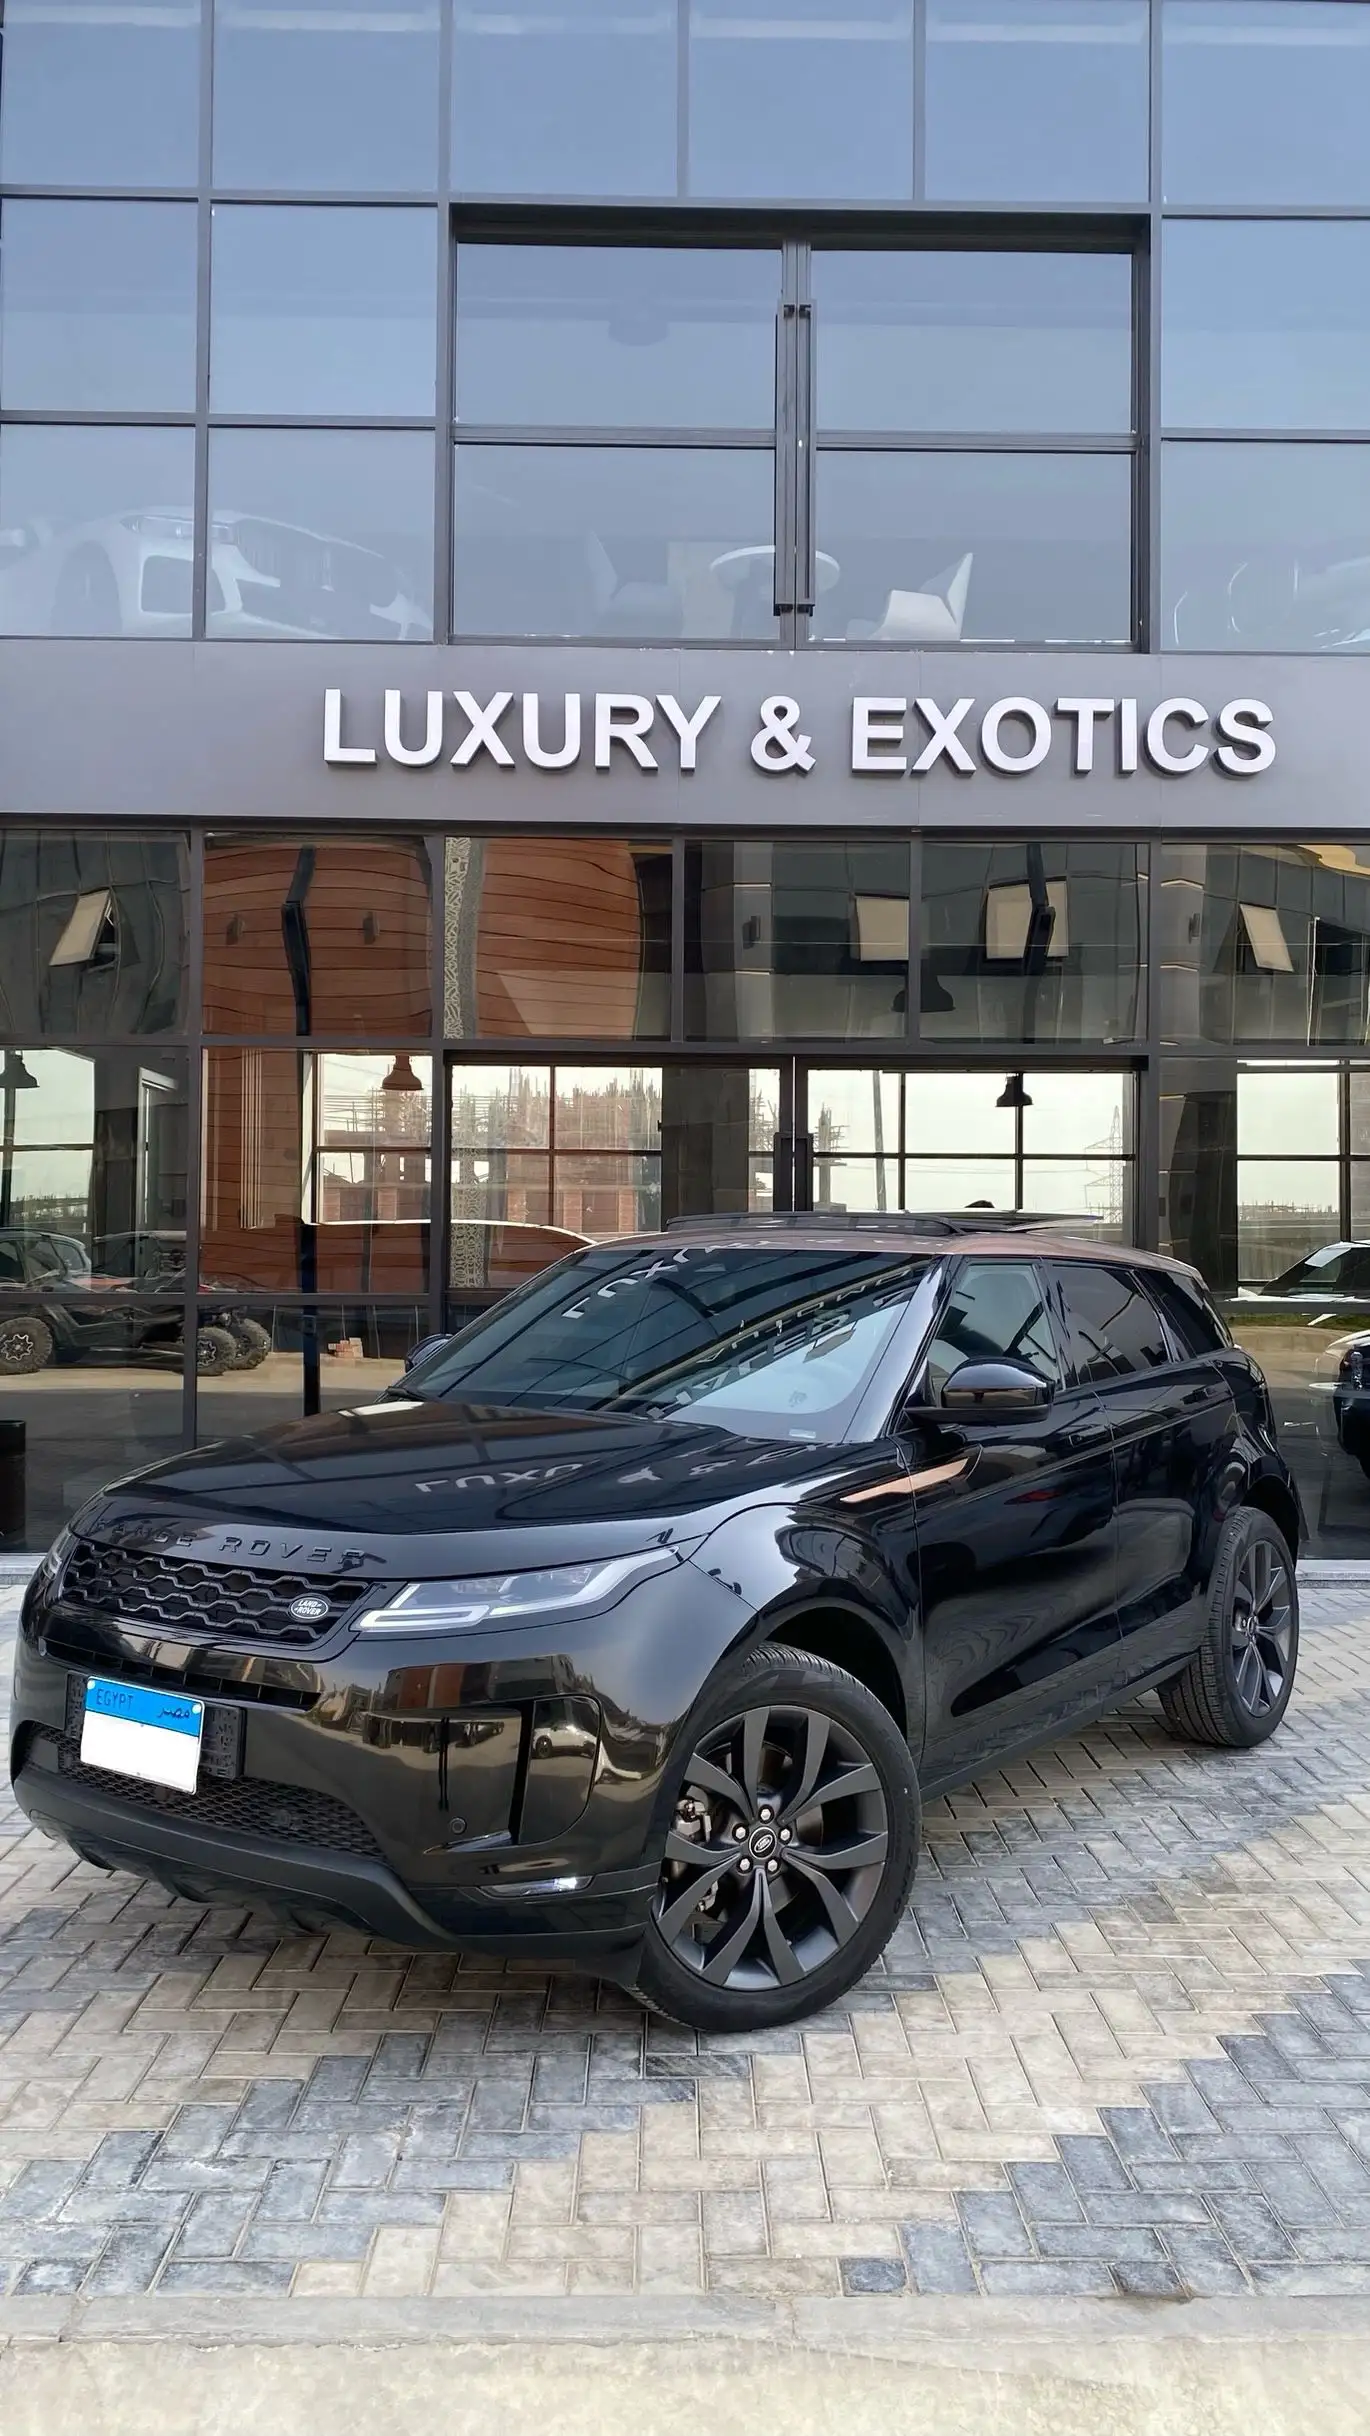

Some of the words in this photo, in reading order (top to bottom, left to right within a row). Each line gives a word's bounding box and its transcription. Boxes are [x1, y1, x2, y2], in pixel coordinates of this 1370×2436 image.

[324, 688, 722, 769] LUXURY
[750, 695, 817, 774] &
[850, 696, 1278, 778] EXOTICS
[219, 1535, 366, 1565] ROVER
[297, 1606, 322, 1615] ROVER
[95, 1689, 133, 1710] EGYPT
[157, 1706, 190, 1719] مصر
